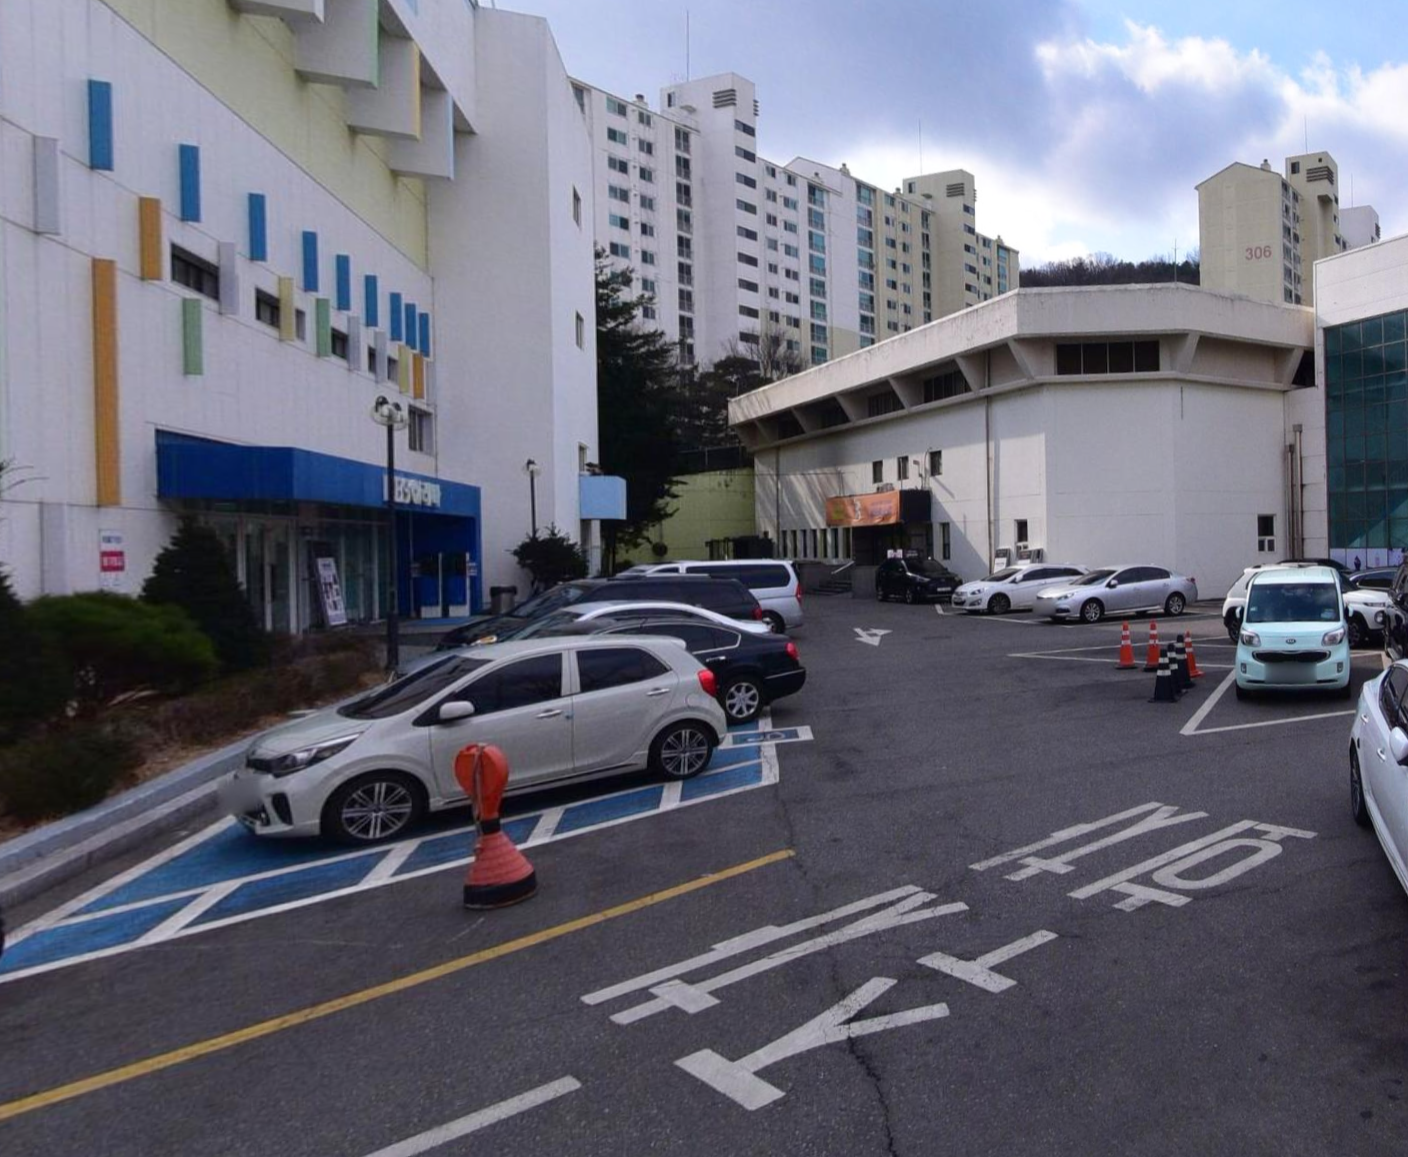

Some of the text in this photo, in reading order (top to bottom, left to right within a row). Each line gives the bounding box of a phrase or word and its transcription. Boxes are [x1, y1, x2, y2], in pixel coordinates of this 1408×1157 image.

[1246, 246, 1272, 260] 306
[967, 802, 1317, 912] 회차
[580, 884, 1059, 1111] 주차
